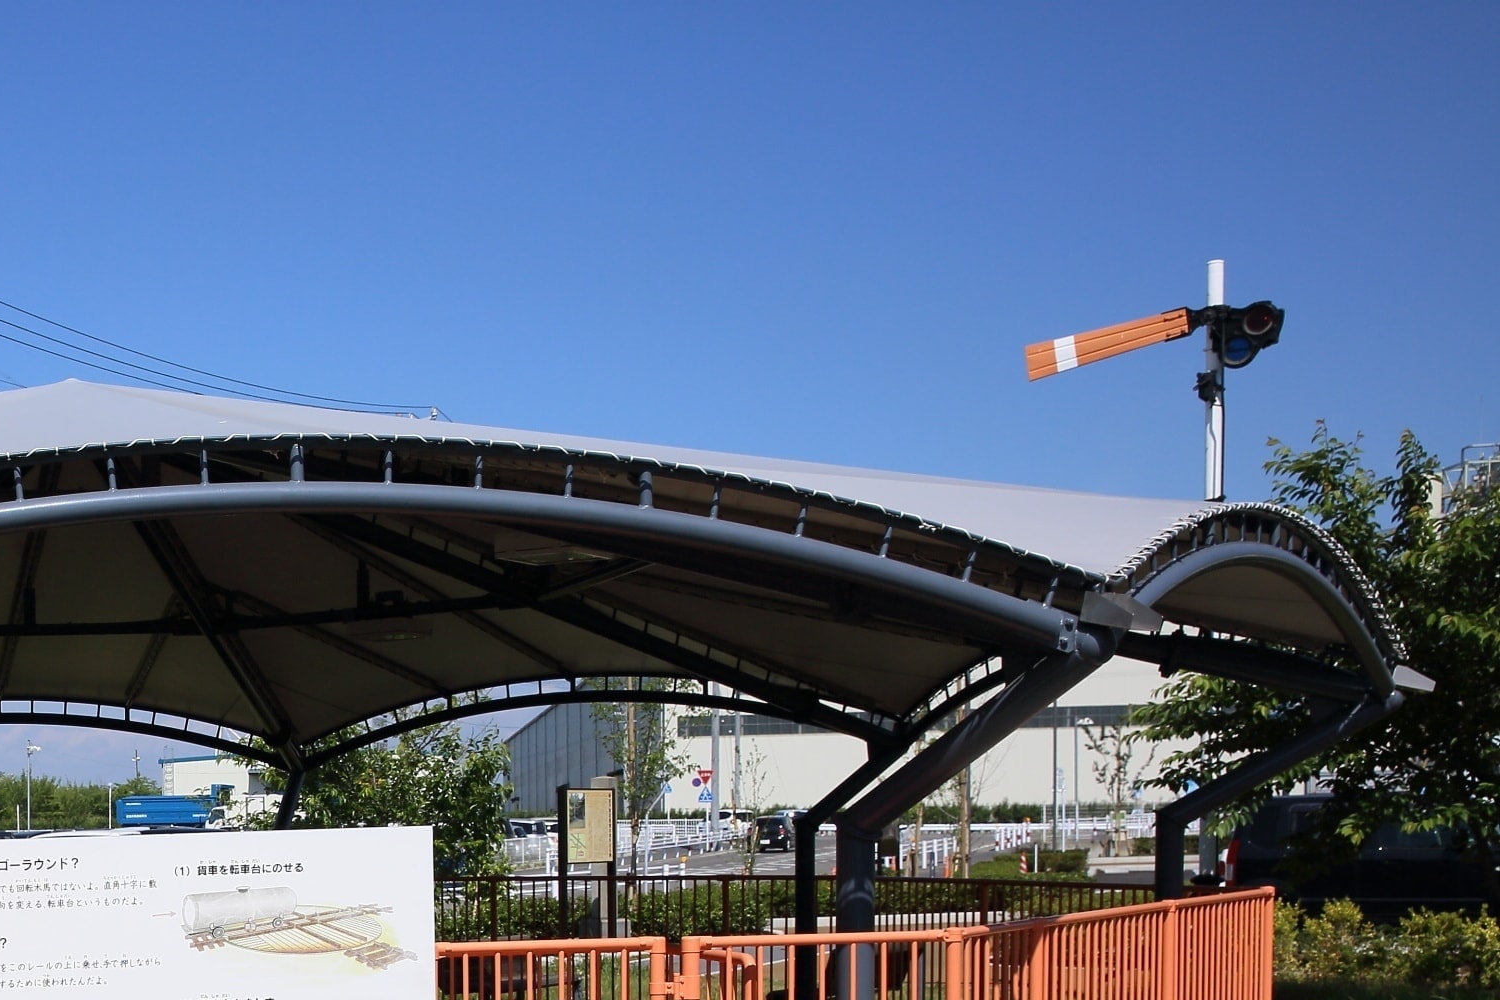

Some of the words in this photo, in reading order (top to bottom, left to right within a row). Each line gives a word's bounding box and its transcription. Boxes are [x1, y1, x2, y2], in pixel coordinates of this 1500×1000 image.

[175, 866, 190, 877] (1)
[197, 862, 303, 876] 貨車を転車台にのせる
